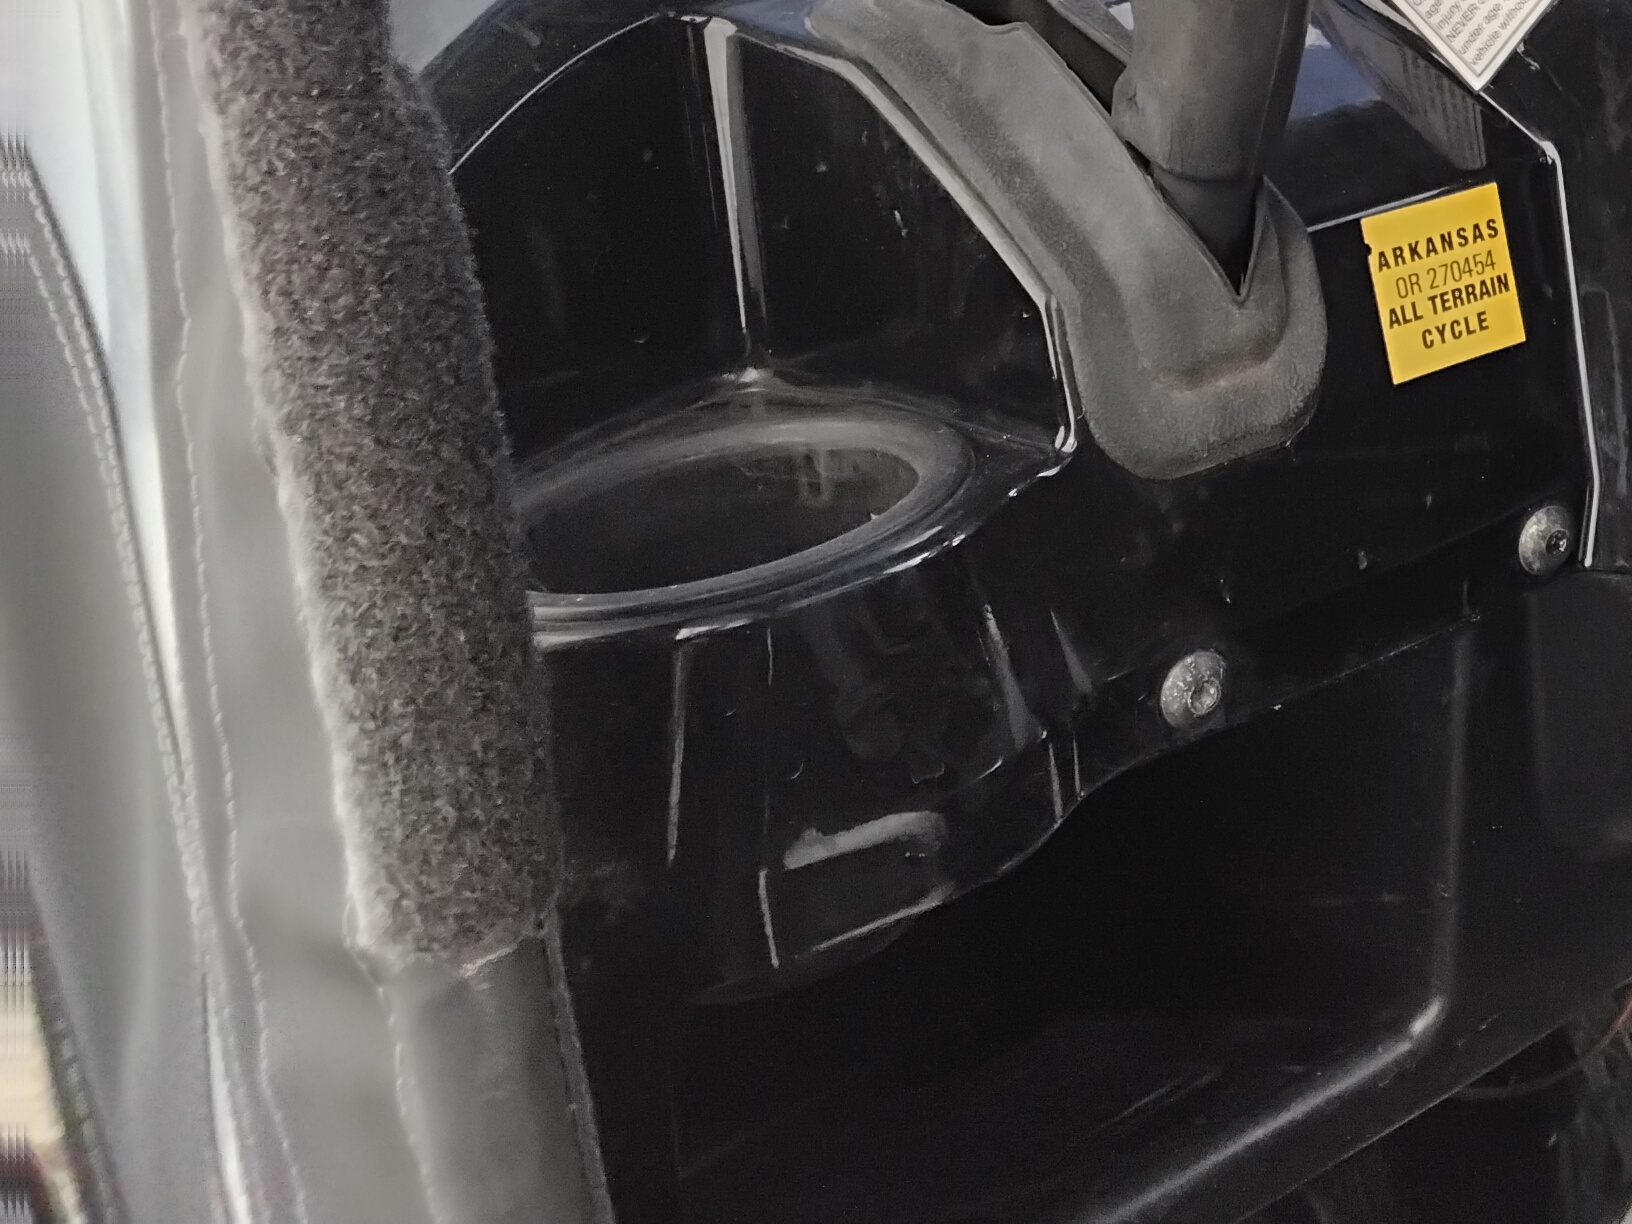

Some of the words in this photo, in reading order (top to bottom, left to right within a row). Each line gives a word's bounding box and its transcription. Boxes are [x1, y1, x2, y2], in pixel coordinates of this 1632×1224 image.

[1432, 0, 1462, 31] injury
[1444, 2, 1480, 43] NEVER
[1457, 22, 1485, 55] under
[1482, 2, 1502, 25] age
[1468, 29, 1501, 65] vehicle
[1377, 218, 1499, 272] ARKANSAS
[1395, 272, 1423, 299] OR
[1427, 249, 1497, 290] 270454
[1388, 301, 1424, 329] ALL
[1427, 272, 1511, 316] TERRAIN
[1421, 310, 1490, 350] CYCLE
